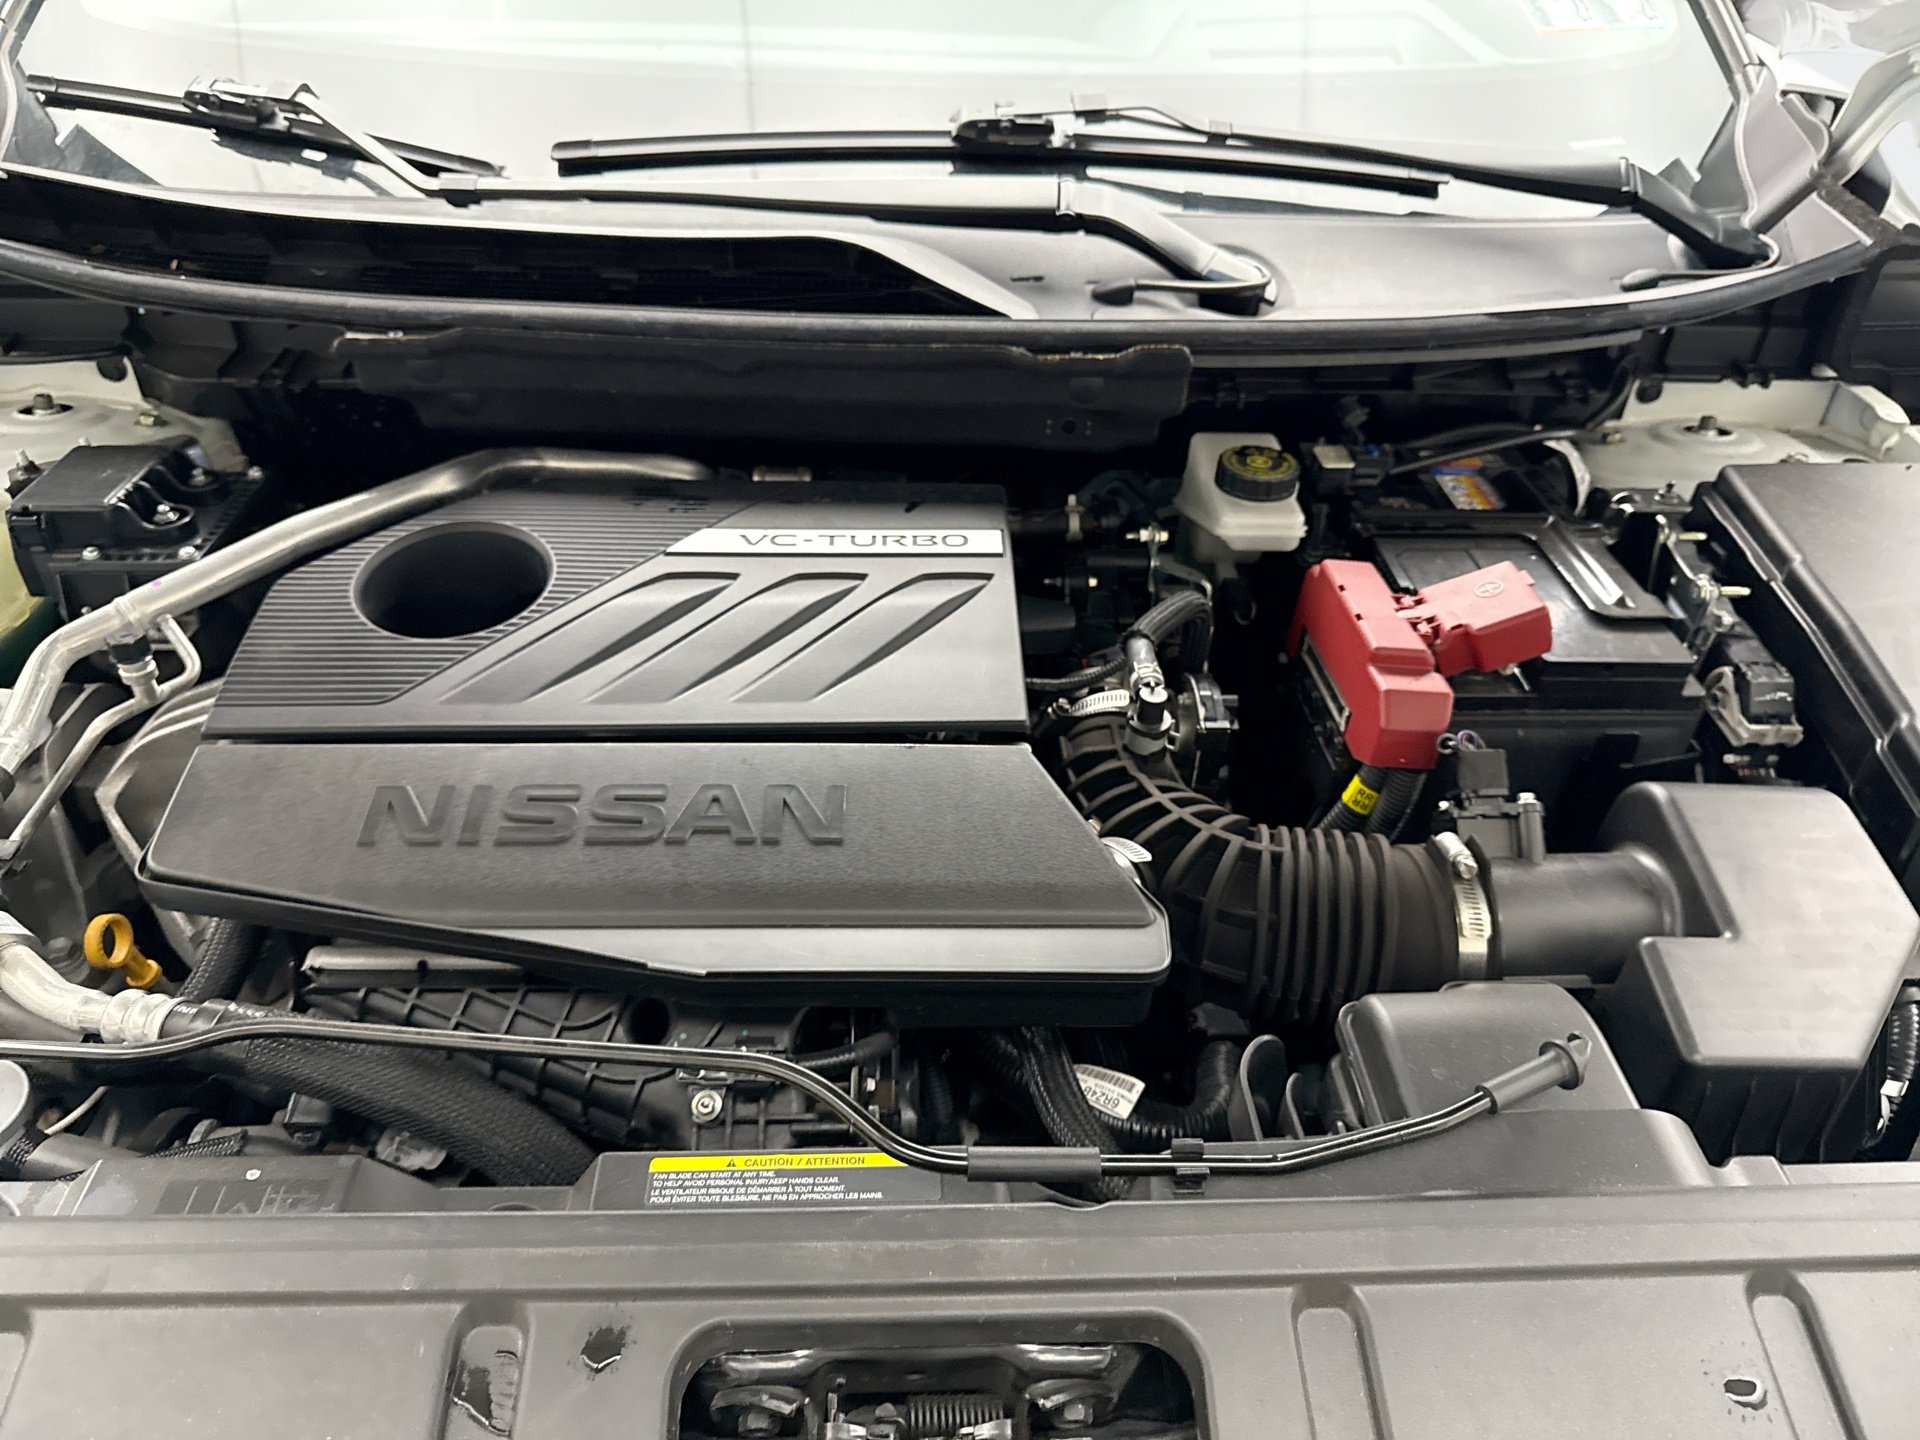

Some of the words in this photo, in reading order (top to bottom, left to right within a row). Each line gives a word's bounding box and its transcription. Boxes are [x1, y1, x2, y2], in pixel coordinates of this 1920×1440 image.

[739, 534, 969, 547] VC-TURBO
[356, 784, 848, 847] NISSAN
[744, 1157, 793, 1168] CAUTION
[805, 1156, 866, 1167] ATTENTION
[710, 1171, 732, 1179] START
[683, 1179, 705, 1187] AVOID
[706, 1178, 745, 1186] PERSONAL
[661, 1188, 708, 1196] VENTILATEUR
[708, 1187, 736, 1195] RISQUE
[747, 1185, 787, 1194] DÉMARRER
[787, 1184, 794, 1193] À
[671, 1194, 697, 1203] ÉVITER
[698, 1195, 722, 1203] TOUTE
[722, 1194, 761, 1202] BLESSURE,
[800, 1192, 845, 1200] APPROCHER
[860, 1191, 884, 1199] MAINS.
